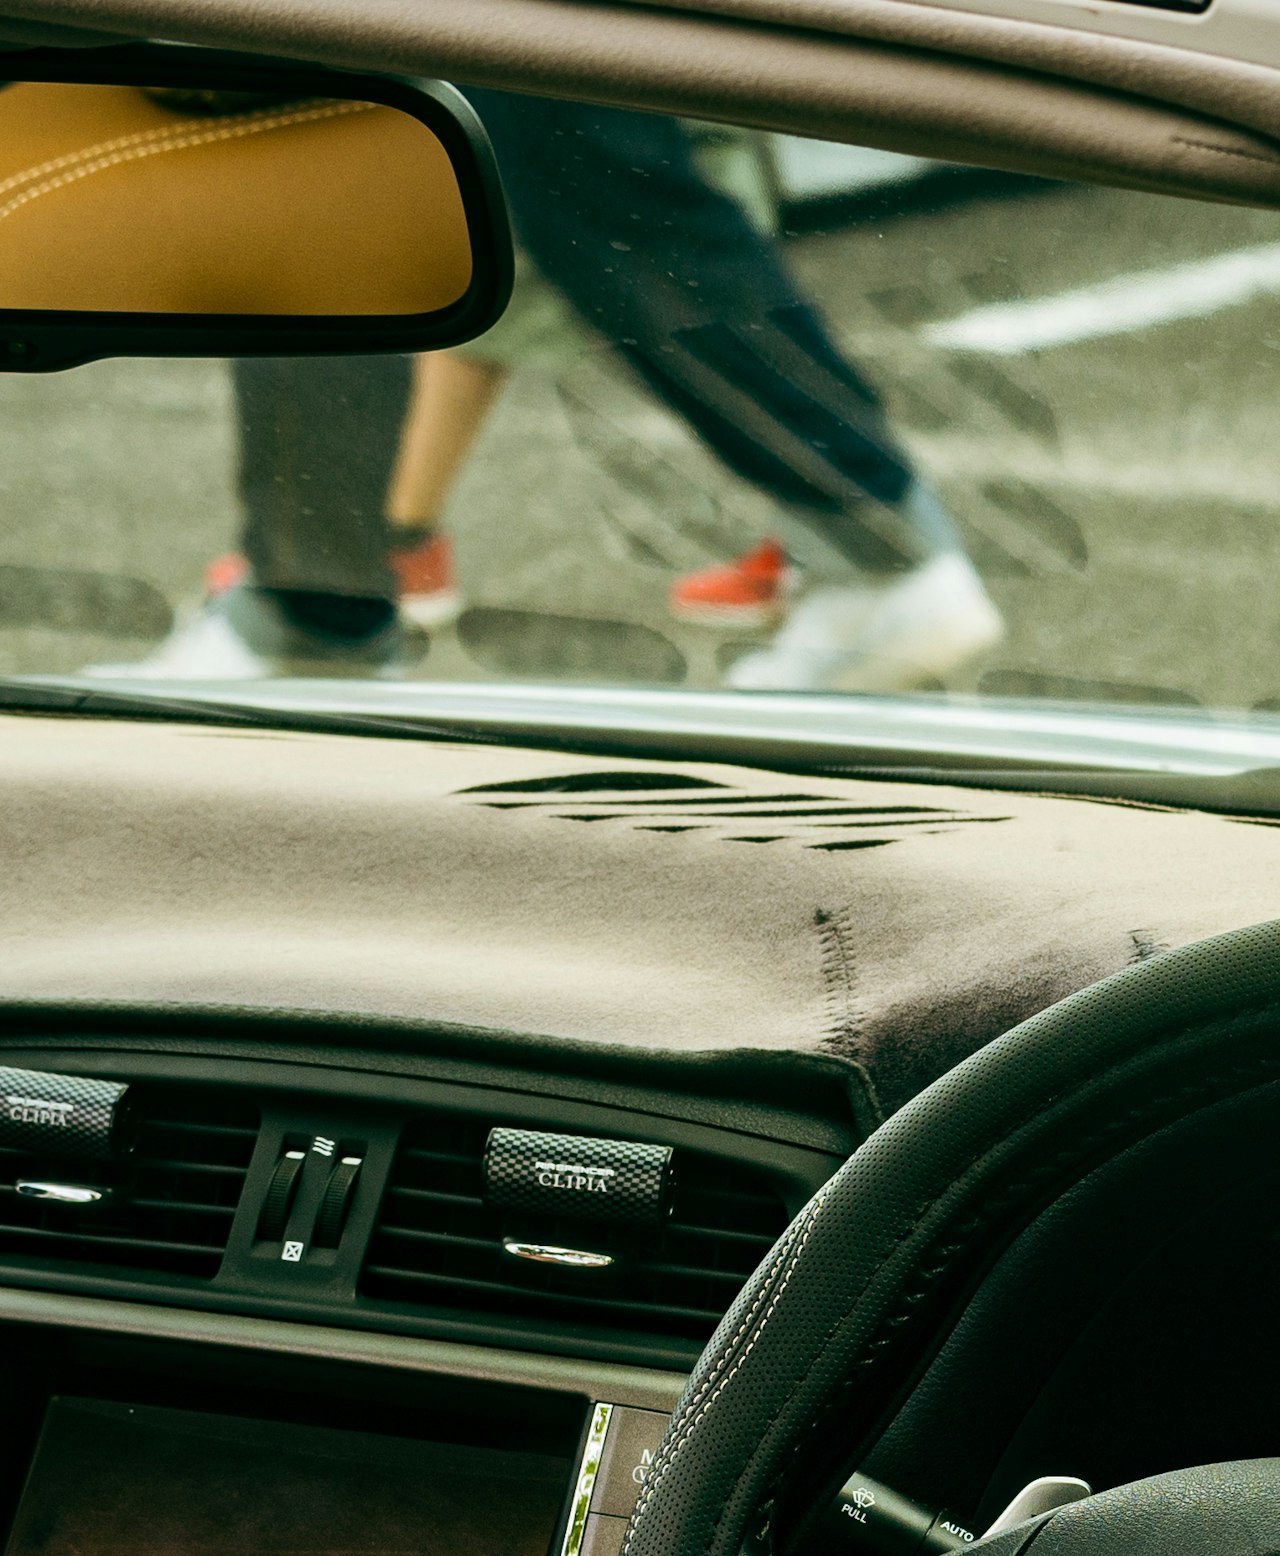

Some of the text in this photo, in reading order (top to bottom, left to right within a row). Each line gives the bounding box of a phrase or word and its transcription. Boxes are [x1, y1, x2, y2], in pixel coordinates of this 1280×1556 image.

[538, 1172, 608, 1193] CLIPIA
[841, 1503, 868, 1524] PULL
[940, 1521, 975, 1543] AUTO
